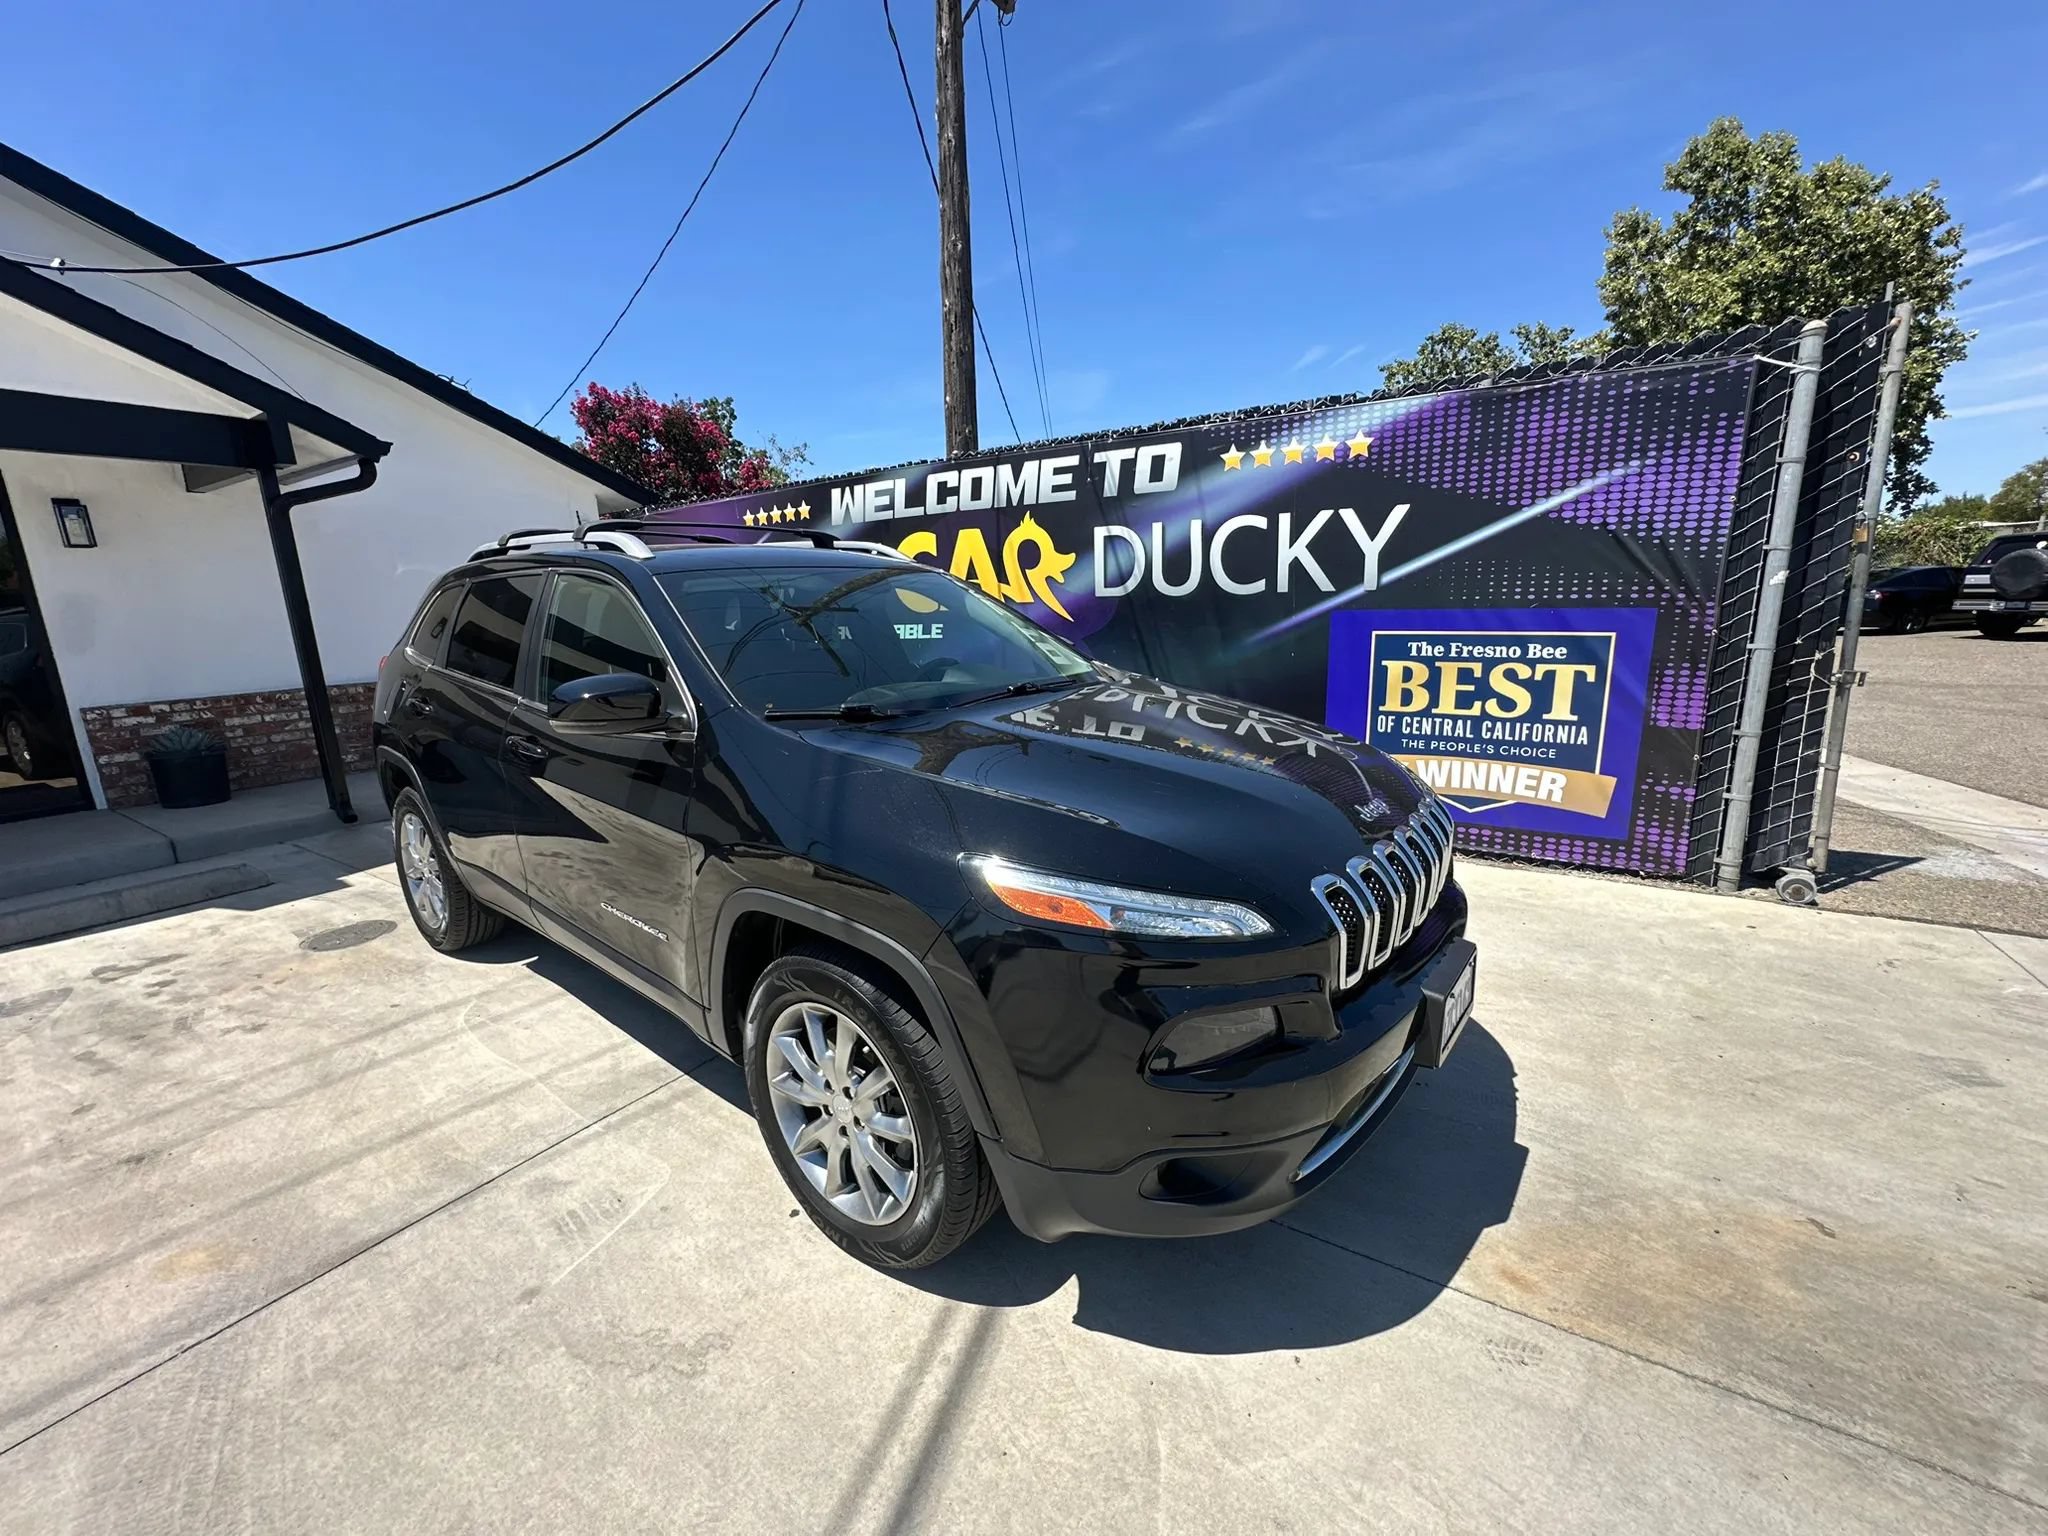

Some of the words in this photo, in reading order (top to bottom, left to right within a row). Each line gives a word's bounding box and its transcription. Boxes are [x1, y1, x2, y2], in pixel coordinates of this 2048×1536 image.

[831, 455, 1080, 526] WELCOME
[1093, 442, 1183, 498] TO
[1093, 503, 1411, 597] DUCKY
[1407, 641, 1444, 657] The
[1449, 642, 1521, 659] Fresno
[1526, 643, 1567, 659] Bee
[1378, 660, 1596, 721] BEST
[1377, 714, 1395, 733] OF
[1401, 716, 1474, 739] CENTRAL
[1481, 720, 1588, 745] CALIFORNIA
[1401, 739, 1425, 750] THE
[1430, 741, 1494, 754] PEOPLE'S
[1500, 745, 1556, 759] CHOICE
[1416, 759, 1567, 803] WINNER
